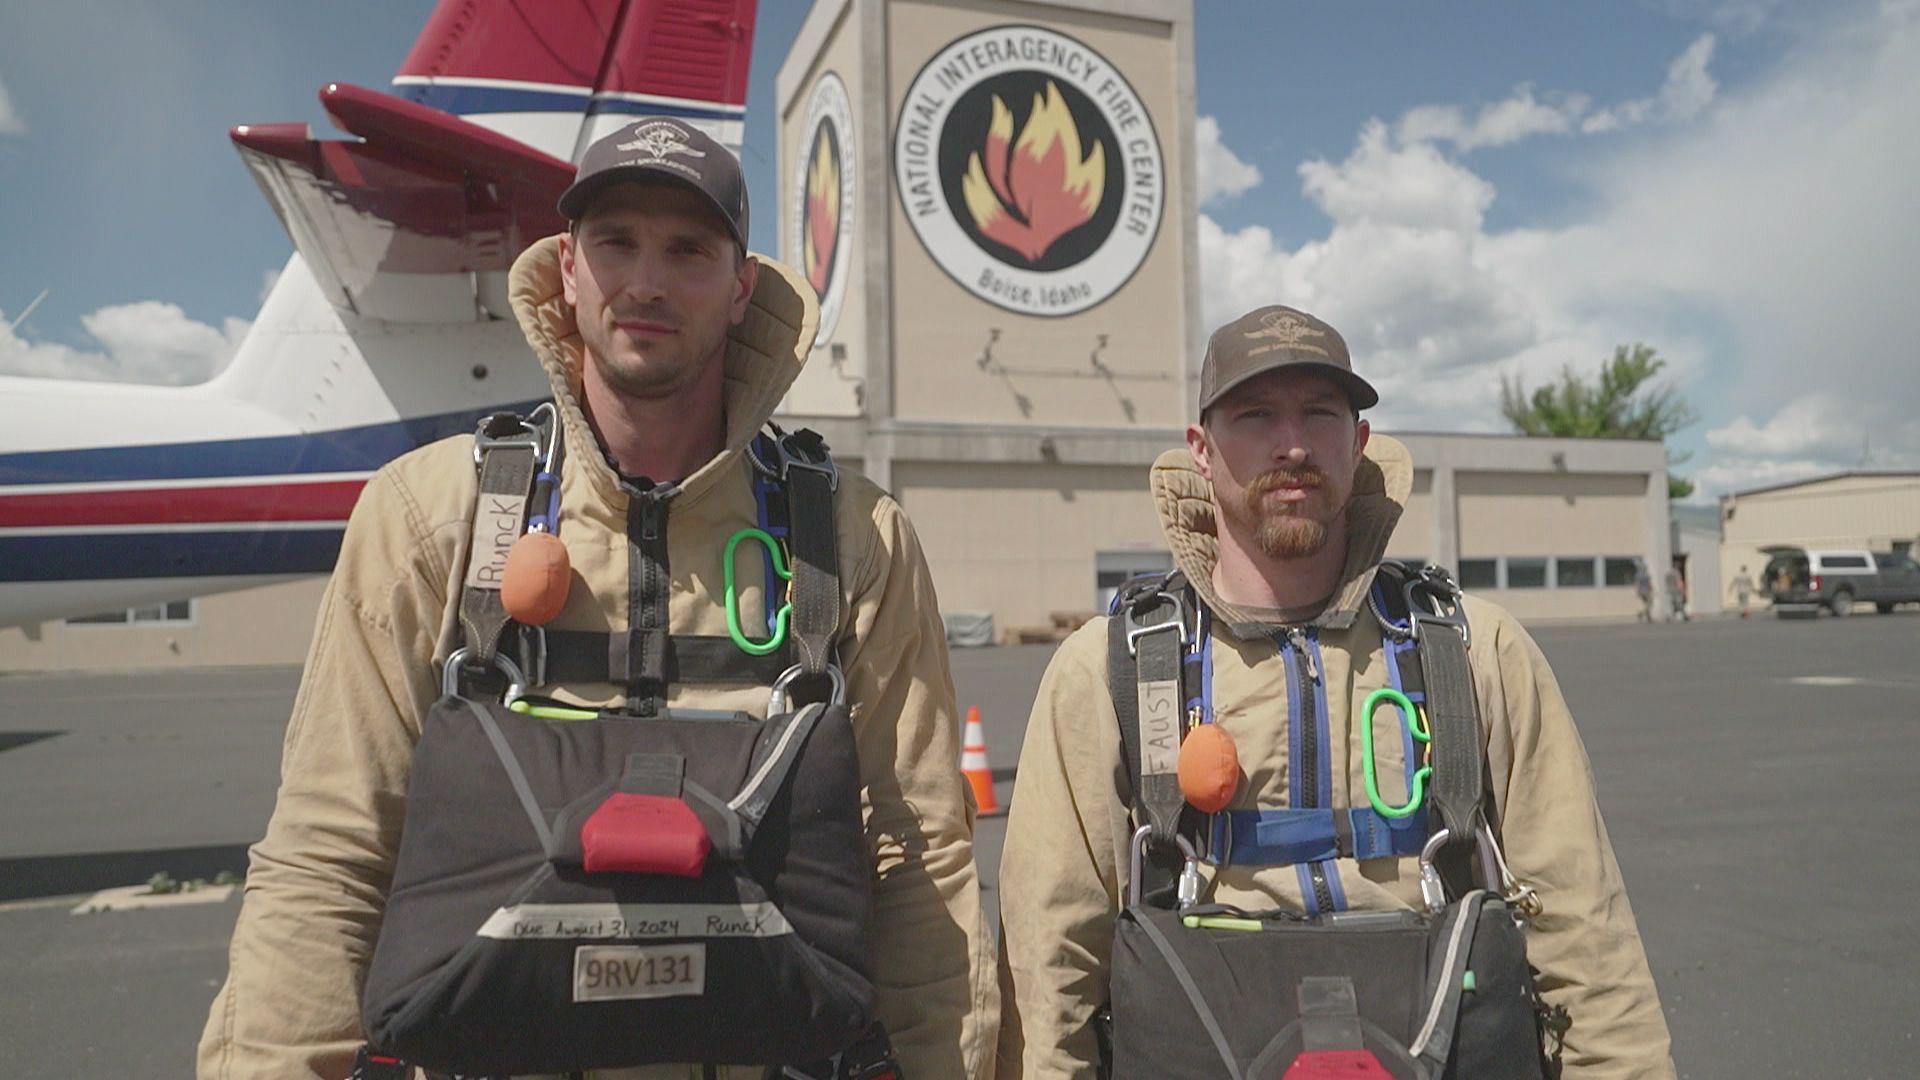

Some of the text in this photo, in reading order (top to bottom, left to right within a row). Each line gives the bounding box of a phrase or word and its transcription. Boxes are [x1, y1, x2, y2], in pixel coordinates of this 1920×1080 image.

[904, 93, 945, 216] NATIONAL
[935, 36, 1098, 91] INTERAGENCY
[1097, 78, 1140, 132] FIRE
[1126, 139, 1154, 236] CENTER
[1145, 682, 1175, 775] FAUST
[555, 920, 604, 937] August
[638, 919, 680, 936] 2024
[584, 955, 695, 989] 9RV131
